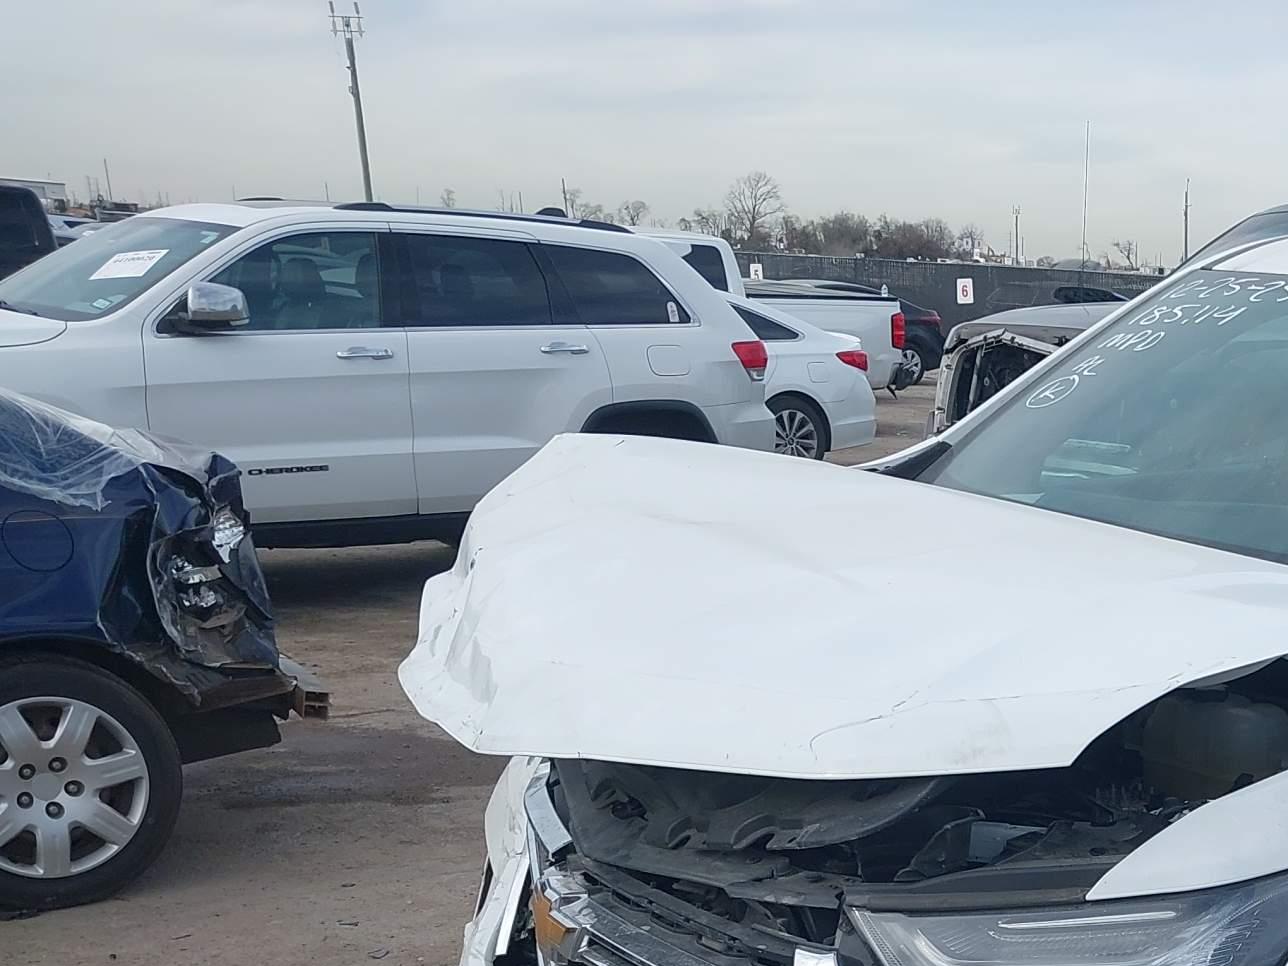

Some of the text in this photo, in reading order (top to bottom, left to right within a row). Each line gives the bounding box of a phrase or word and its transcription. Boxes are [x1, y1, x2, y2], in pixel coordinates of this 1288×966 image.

[961, 284, 969, 298] 6
[1097, 329, 1167, 352] MPD
[247, 464, 330, 477] CHEROKEE
